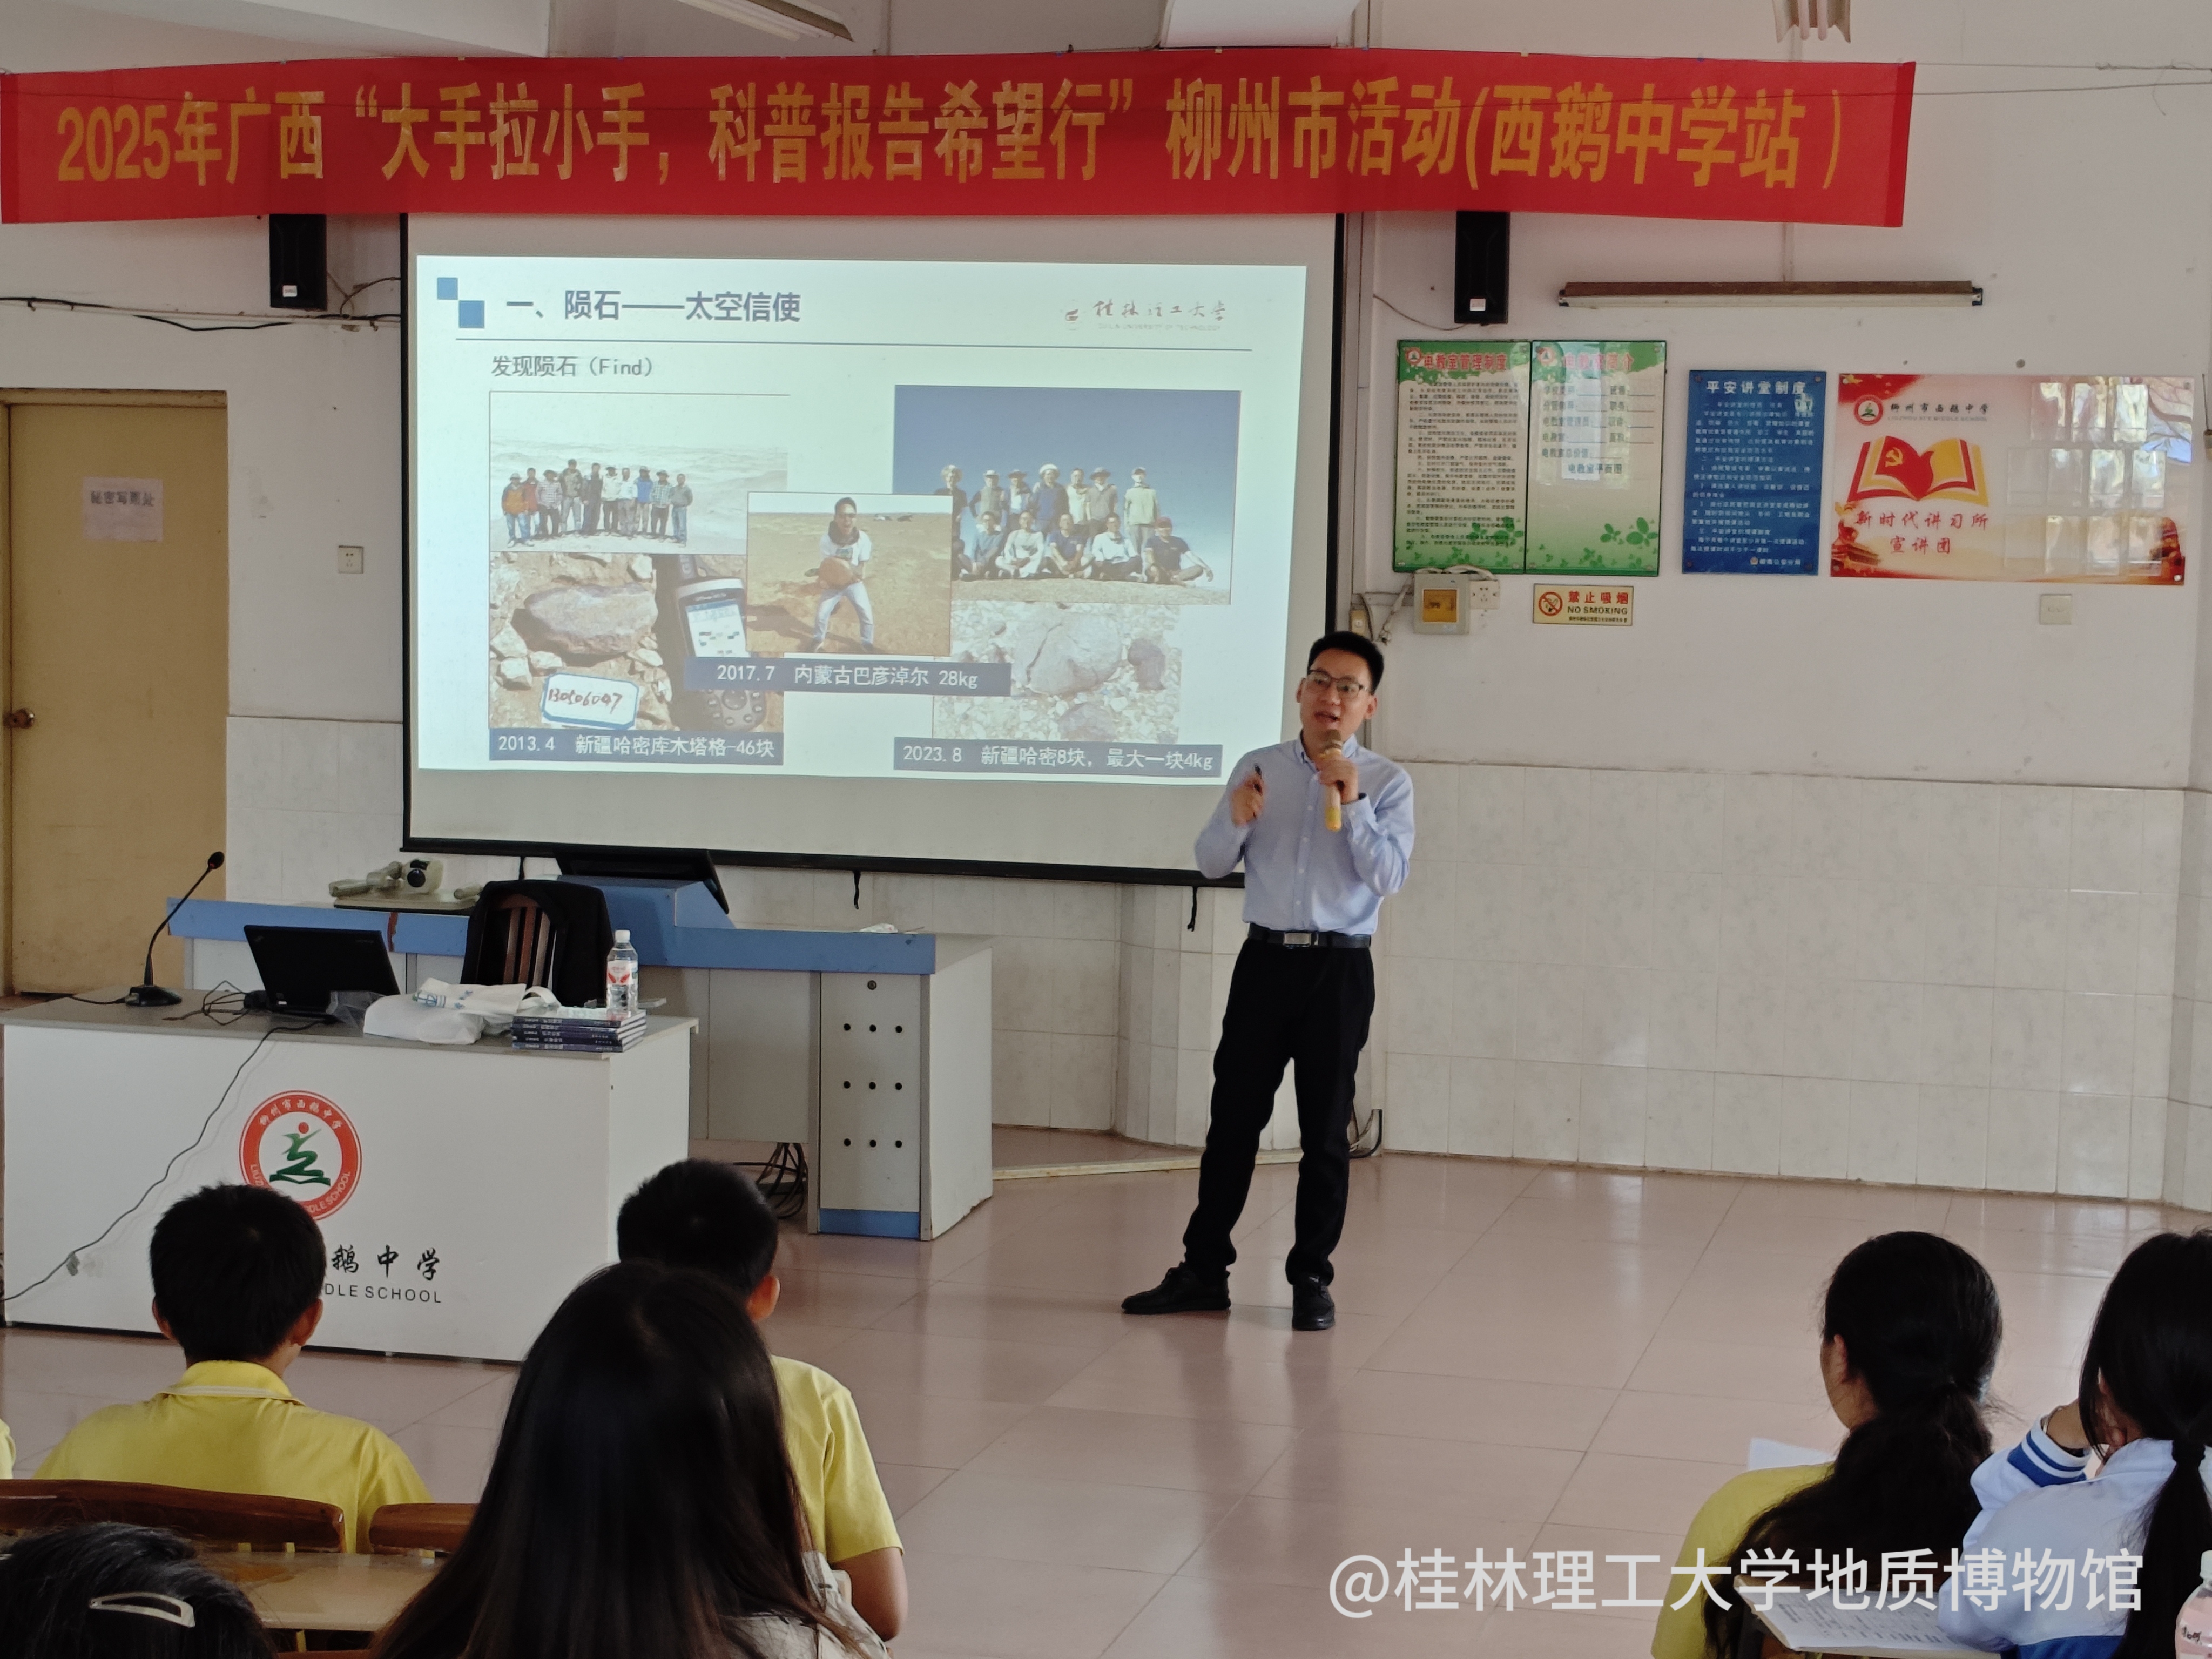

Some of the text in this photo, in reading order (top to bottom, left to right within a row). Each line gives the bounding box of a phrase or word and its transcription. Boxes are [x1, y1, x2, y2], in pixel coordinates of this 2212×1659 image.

[1856, 511, 1988, 530] 新时代讲习所
[1890, 536, 1950, 555] 宣讲团
[1568, 590, 1629, 604] 禁止吸烟
[1567, 606, 1581, 614] NO
[717, 665, 775, 681] 2017.7
[939, 670, 979, 689] 28kg
[499, 736, 555, 752] 2013.4
[903, 745, 962, 763] 2023.8
[331, 1244, 440, 1281] 鹅中学
[365, 1286, 441, 1303] SCHOOL
